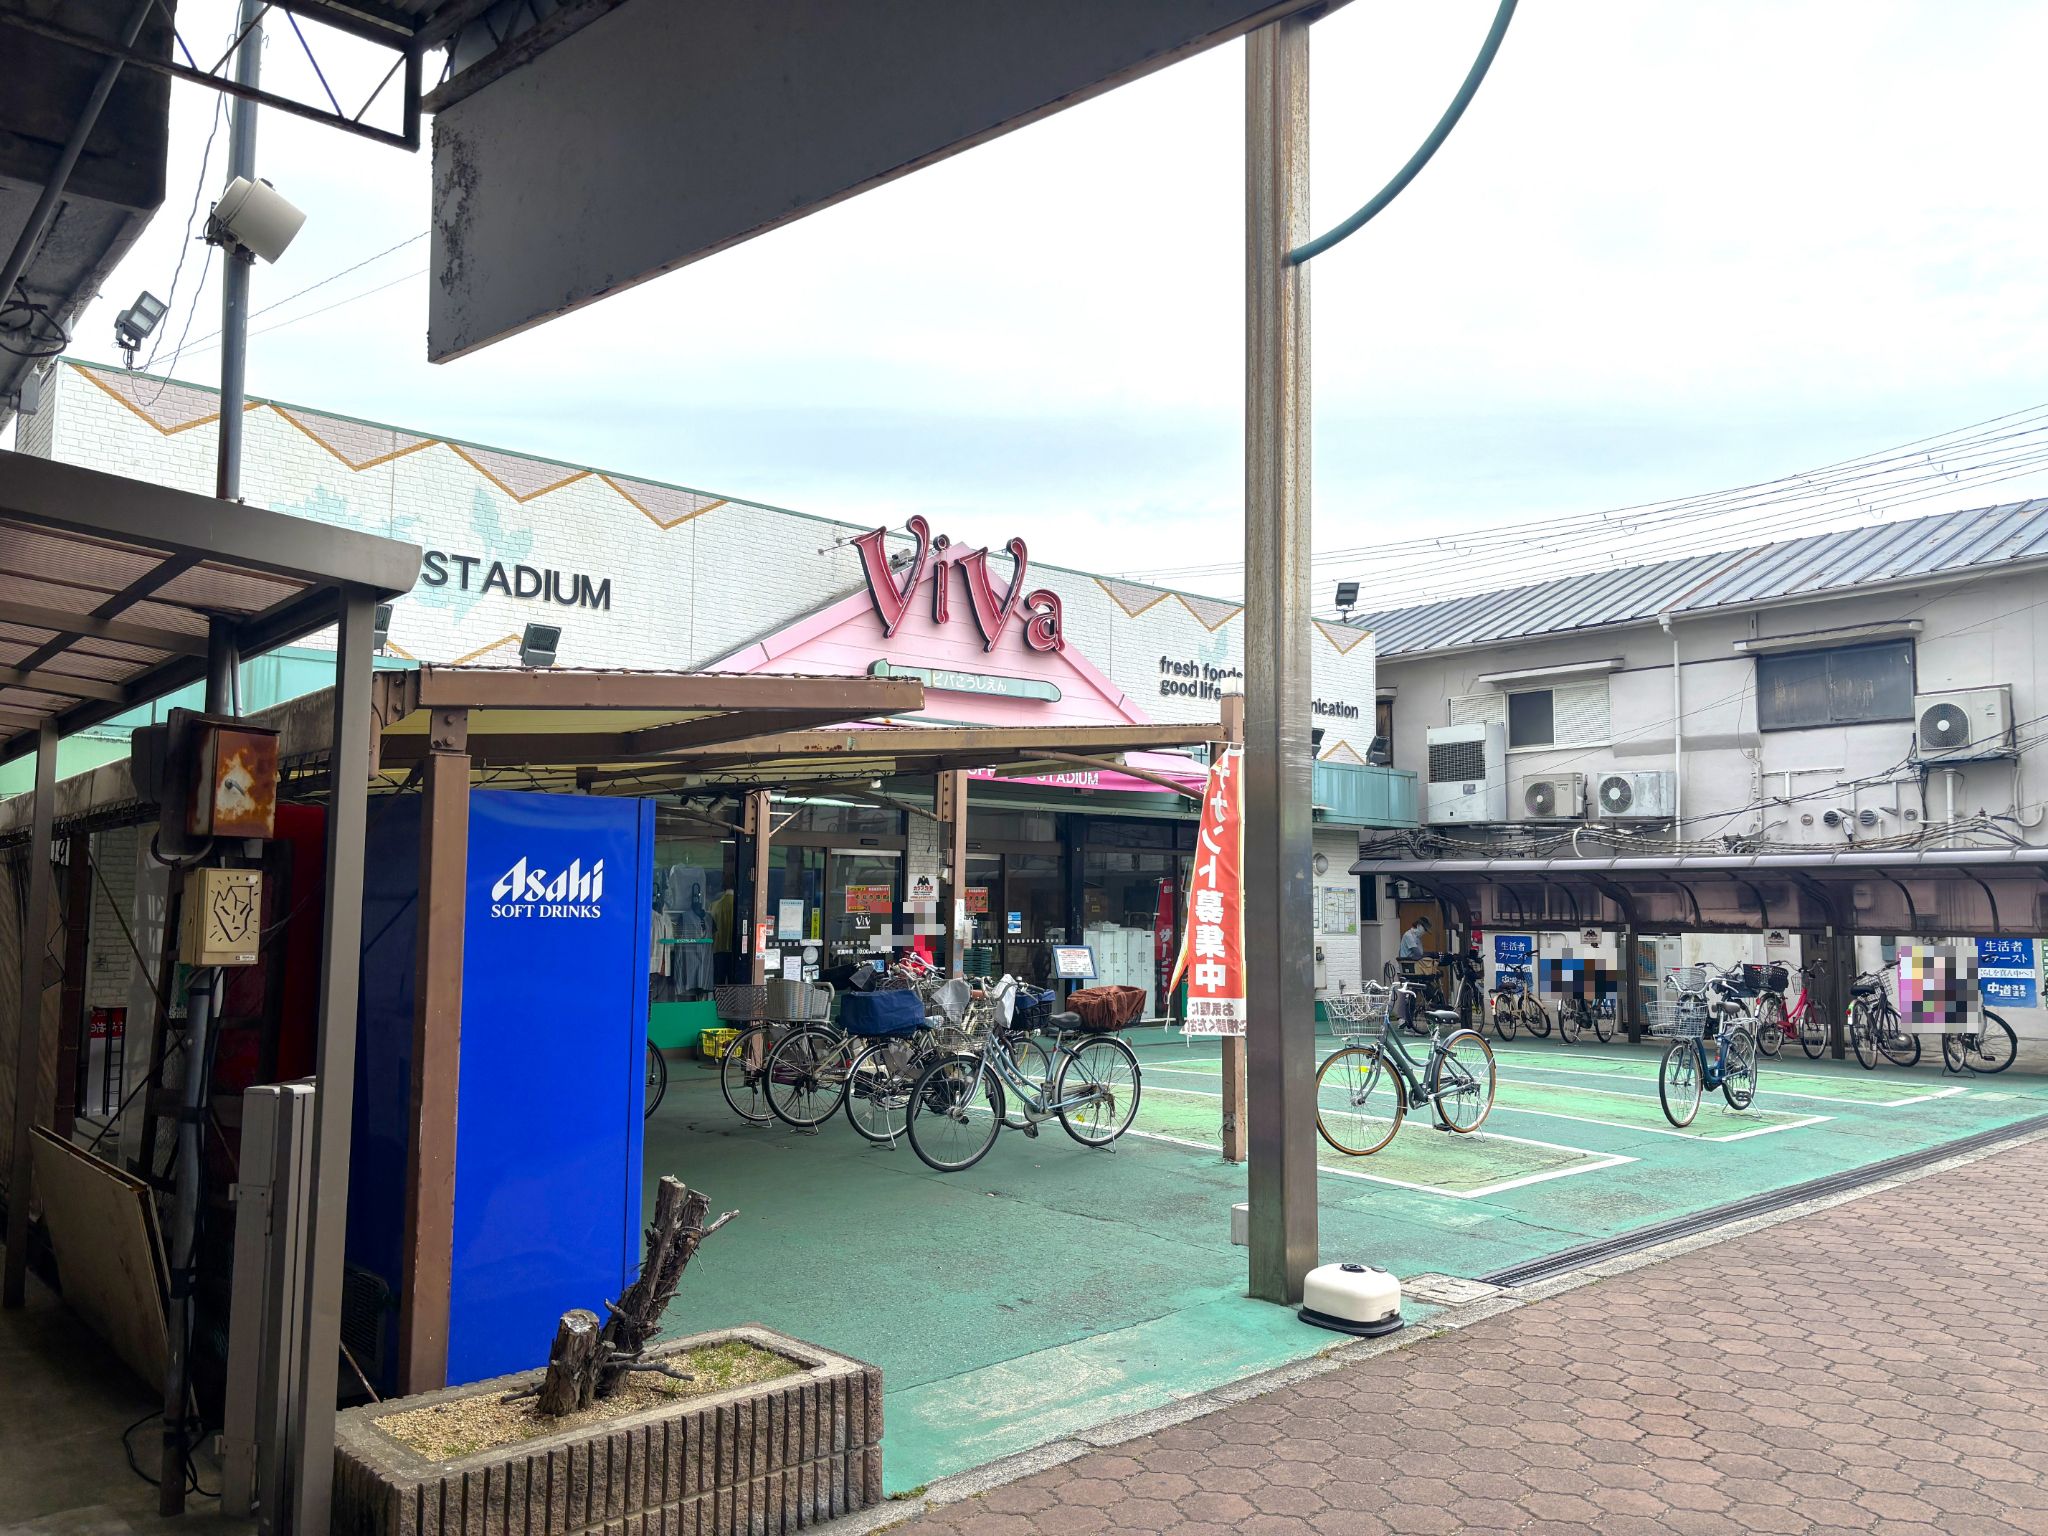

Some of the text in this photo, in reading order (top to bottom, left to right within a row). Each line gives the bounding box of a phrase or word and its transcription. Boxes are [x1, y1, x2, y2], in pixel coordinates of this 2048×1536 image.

[420, 549, 612, 611] STADIUM
[851, 514, 1065, 653] ViVa
[1159, 656, 1200, 679] fresh
[1159, 678, 1222, 701] good life
[1311, 698, 1359, 719] nication
[491, 856, 604, 902] Asahi
[491, 904, 601, 918] SOFT DRINKS
[1501, 941, 1526, 951] 生活者
[1985, 940, 2023, 953] 生活者
[1981, 953, 2028, 964] ファースト
[1987, 981, 2012, 997] 中道
